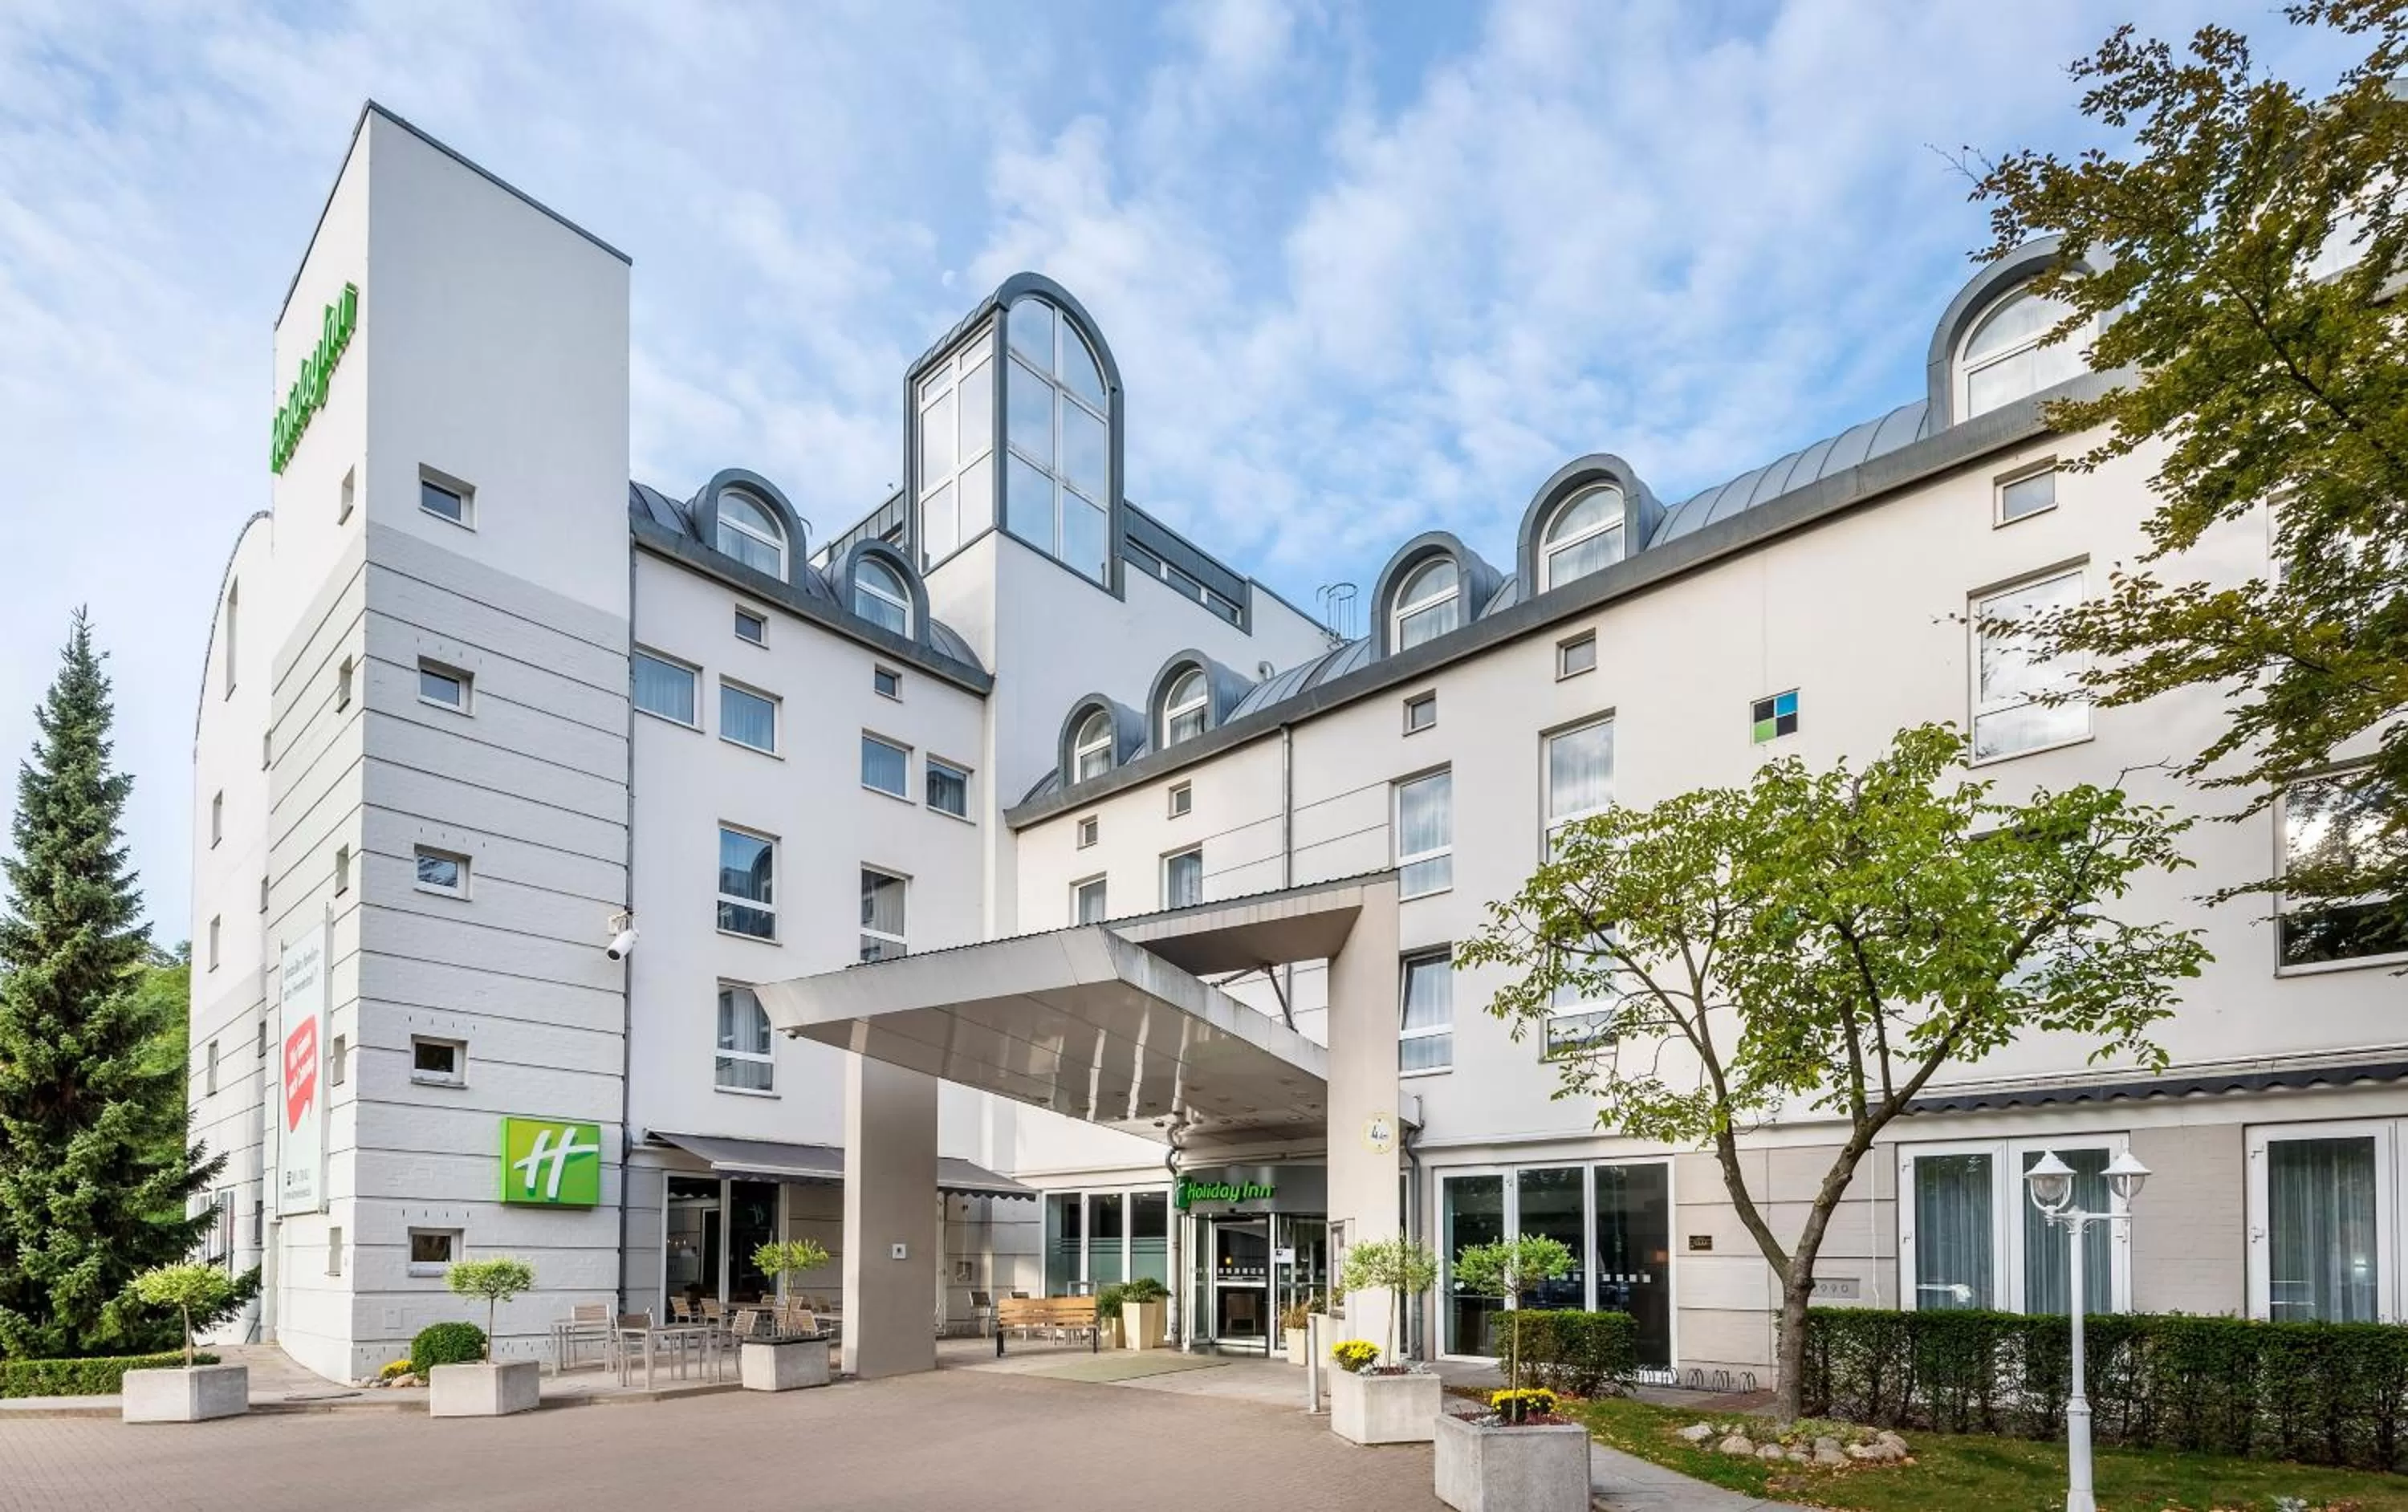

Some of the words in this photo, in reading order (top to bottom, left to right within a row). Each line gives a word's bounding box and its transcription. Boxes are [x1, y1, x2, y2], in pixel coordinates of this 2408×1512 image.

[270, 339, 324, 474] Holiday
[514, 1127, 600, 1201] H
[1188, 1181, 1240, 1202] Holiday
[1243, 1180, 1272, 1197] Inn
